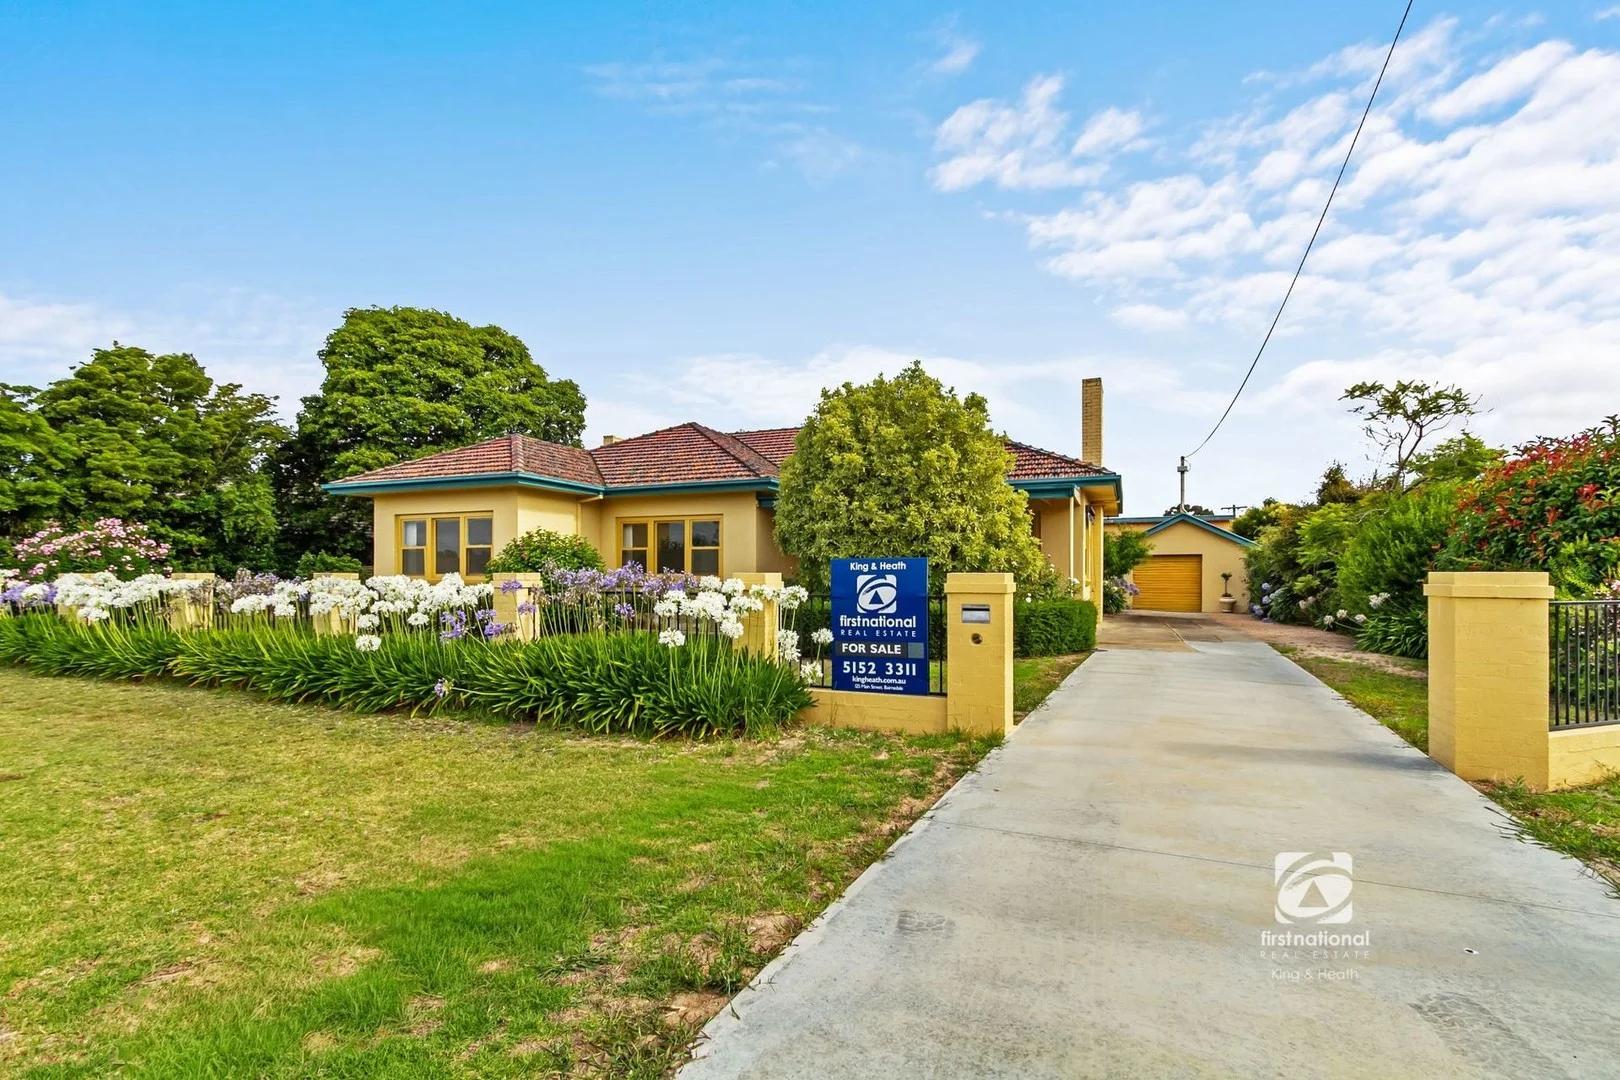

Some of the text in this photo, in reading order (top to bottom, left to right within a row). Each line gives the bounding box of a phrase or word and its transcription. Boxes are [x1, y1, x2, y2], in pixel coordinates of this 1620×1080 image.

[850, 562, 906, 572] King & Heath
[840, 614, 916, 628] firstnational
[876, 630, 916, 638] ESTATE
[842, 642, 902, 654] FOR SALE
[842, 660, 916, 676] 5152 3311
[852, 676, 906, 684] kingheath.com.au
